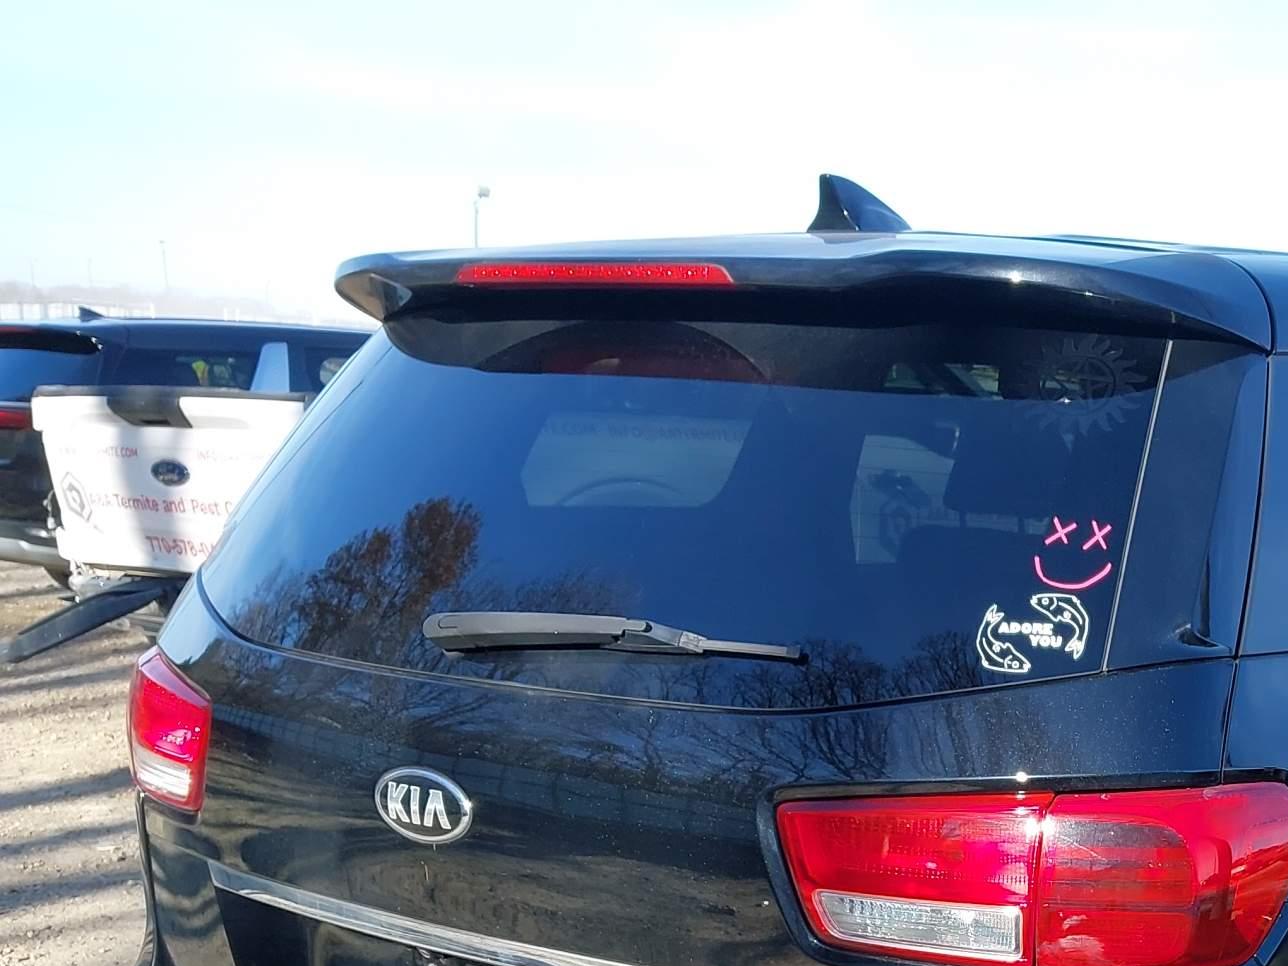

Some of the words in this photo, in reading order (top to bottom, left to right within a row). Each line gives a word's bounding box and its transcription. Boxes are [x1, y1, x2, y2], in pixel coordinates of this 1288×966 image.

[112, 494, 160, 513] Termite
[162, 497, 186, 513] and
[190, 499, 221, 516] Pest
[997, 621, 1055, 636] ADORE
[1029, 633, 1063, 648] YOU
[387, 781, 452, 830] KIA
